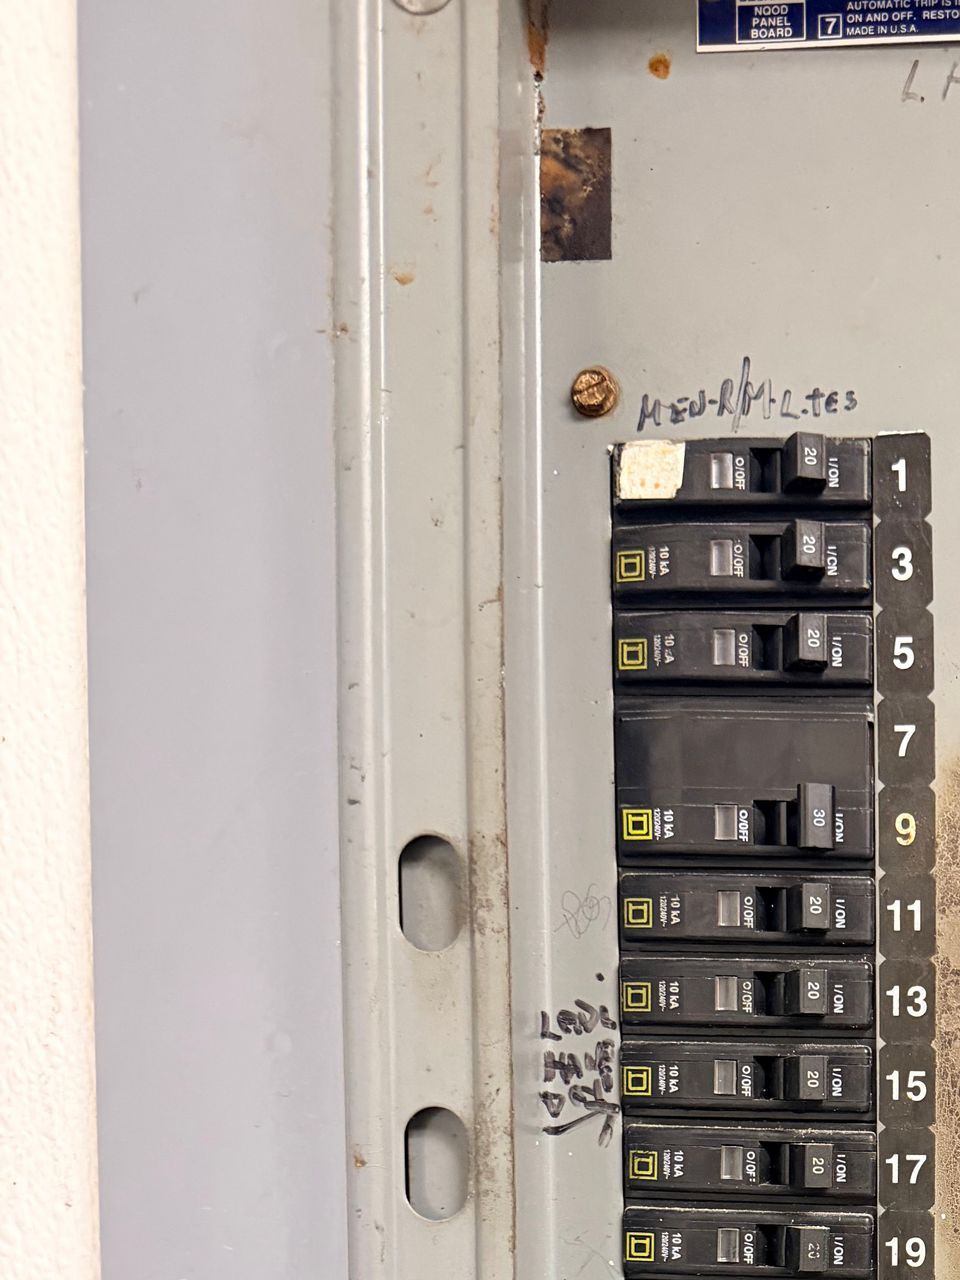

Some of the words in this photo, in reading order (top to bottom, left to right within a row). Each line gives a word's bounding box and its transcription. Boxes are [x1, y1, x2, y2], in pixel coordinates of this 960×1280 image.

[752, 17, 791, 27] PANEL
[825, 18, 837, 34] 7
[847, 15, 862, 23] ON
[866, 13, 888, 23] AND
[892, 12, 916, 21] OFF.
[751, 28, 792, 38] BOARD
[846, 26, 875, 36] MADE
[877, 25, 888, 34] IN
[890, 24, 919, 34] U.S.A.
[805, 447, 817, 465] 20
[892, 459, 907, 491] 1
[803, 536, 815, 553] 20
[891, 548, 913, 581] 3
[808, 629, 819, 648] 20
[893, 637, 914, 669] 5
[894, 725, 916, 757] 7
[813, 809, 825, 827] 30
[895, 813, 916, 846] 9
[809, 897, 822, 914] 20
[887, 900, 921, 932] 11
[807, 982, 819, 999] 20
[886, 986, 927, 1017] 13
[807, 1070, 819, 1088] 20
[886, 1070, 927, 1102] 15
[813, 1157, 824, 1175] 20
[886, 1155, 927, 1185] 17
[886, 1237, 927, 1267] 19
